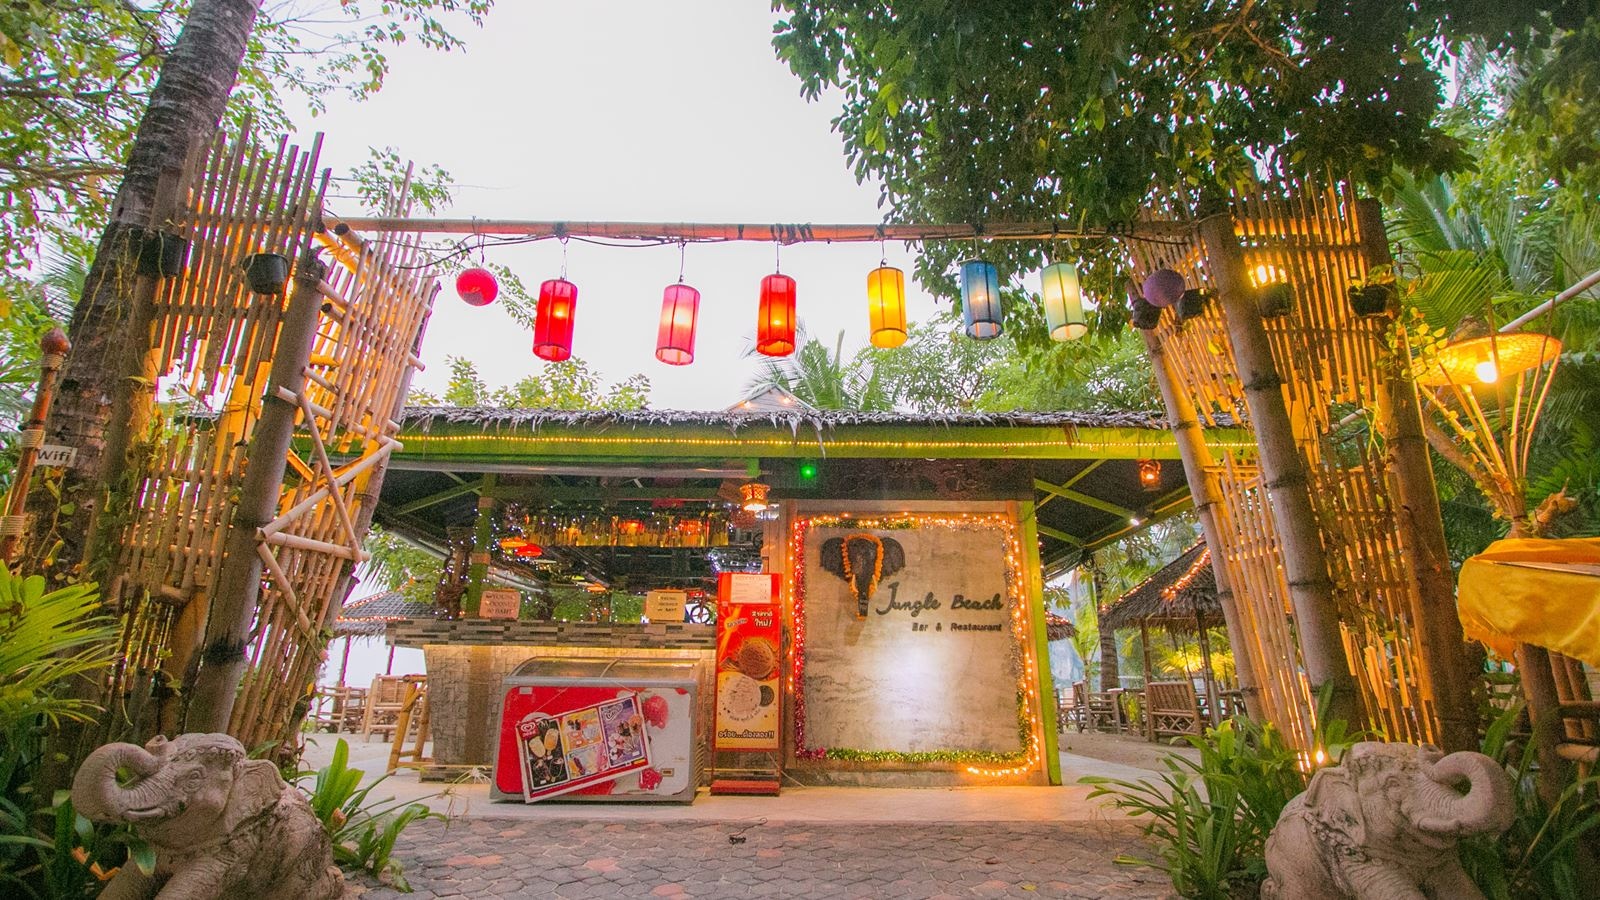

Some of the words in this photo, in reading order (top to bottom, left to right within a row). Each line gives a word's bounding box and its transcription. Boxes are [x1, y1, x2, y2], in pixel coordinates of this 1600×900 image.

[37, 450, 71, 461] Wifi
[875, 581, 942, 617] Jungle
[950, 593, 1004, 610] Beach
[911, 622, 929, 632] Bar
[935, 622, 942, 632] &
[950, 622, 1002, 632] Restaurant
